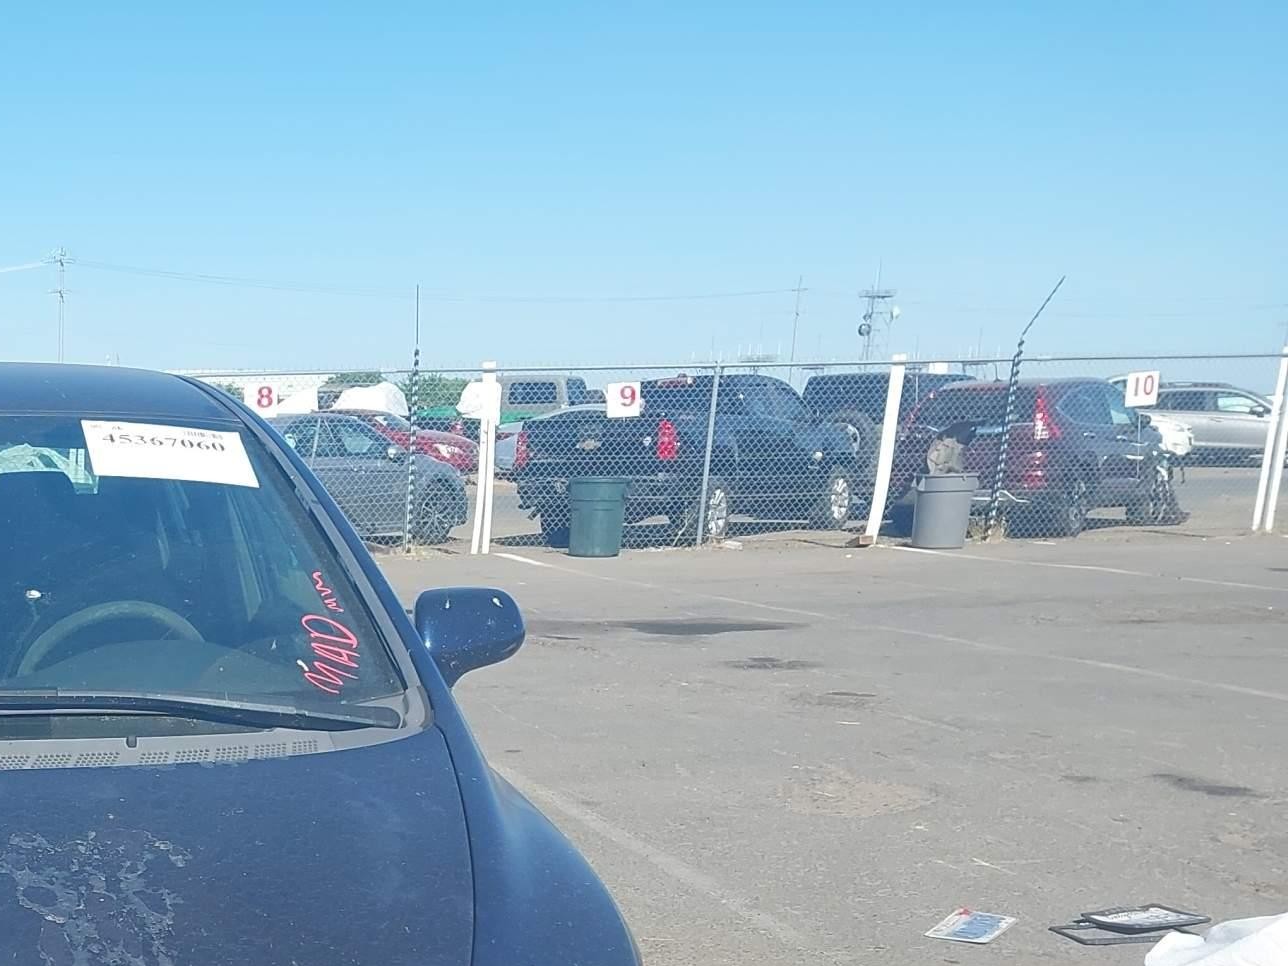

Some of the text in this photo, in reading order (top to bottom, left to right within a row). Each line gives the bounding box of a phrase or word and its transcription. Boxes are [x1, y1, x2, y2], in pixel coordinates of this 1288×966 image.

[257, 386, 273, 408] 8
[620, 385, 636, 407] 9
[1134, 375, 1155, 397] 10
[102, 433, 226, 452] 45367060
